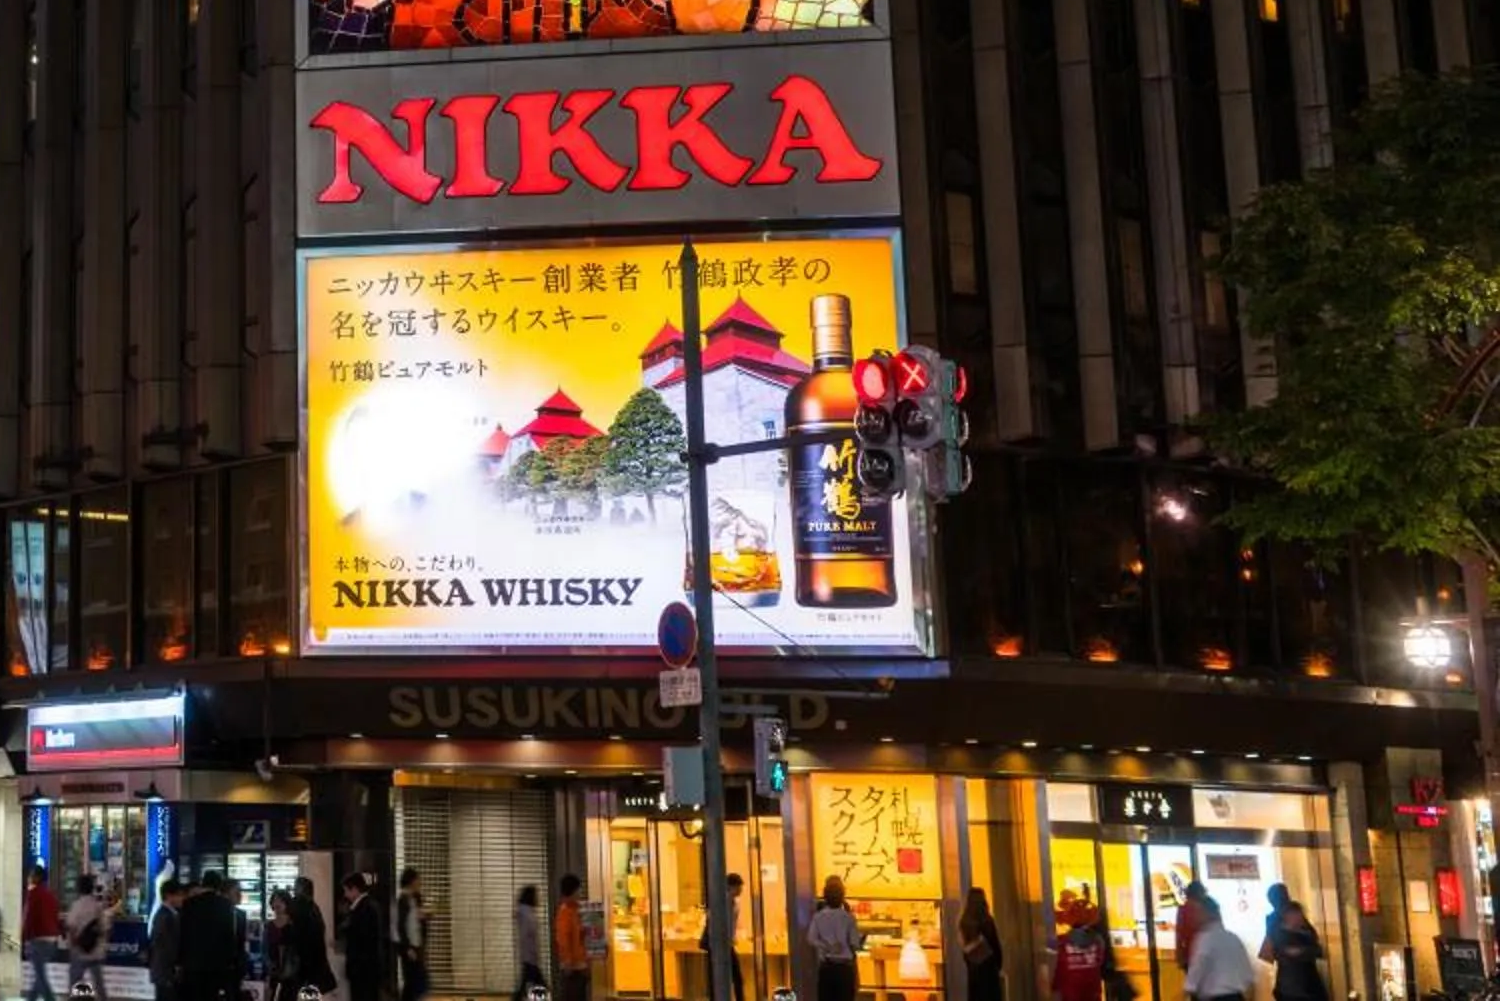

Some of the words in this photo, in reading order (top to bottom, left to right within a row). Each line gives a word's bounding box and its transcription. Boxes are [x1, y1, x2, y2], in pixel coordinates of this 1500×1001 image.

[307, 72, 885, 206] NIKKA
[327, 260, 643, 299] ニッカウヰスキー創業者
[329, 306, 627, 341] 名を冠するウイスキー。
[328, 356, 490, 385] 竹鶴ピュアモルト
[818, 438, 861, 521] 竹鶴
[806, 521, 840, 533] PURE
[842, 519, 878, 533] MALT
[334, 552, 488, 575] 本物への、こだわり。
[332, 577, 477, 610] NIKKA
[480, 576, 645, 609] WHISKY
[388, 686, 686, 730] SUSUKINO
[830, 784, 857, 884] スクエア
[861, 785, 893, 884] タイムズ
